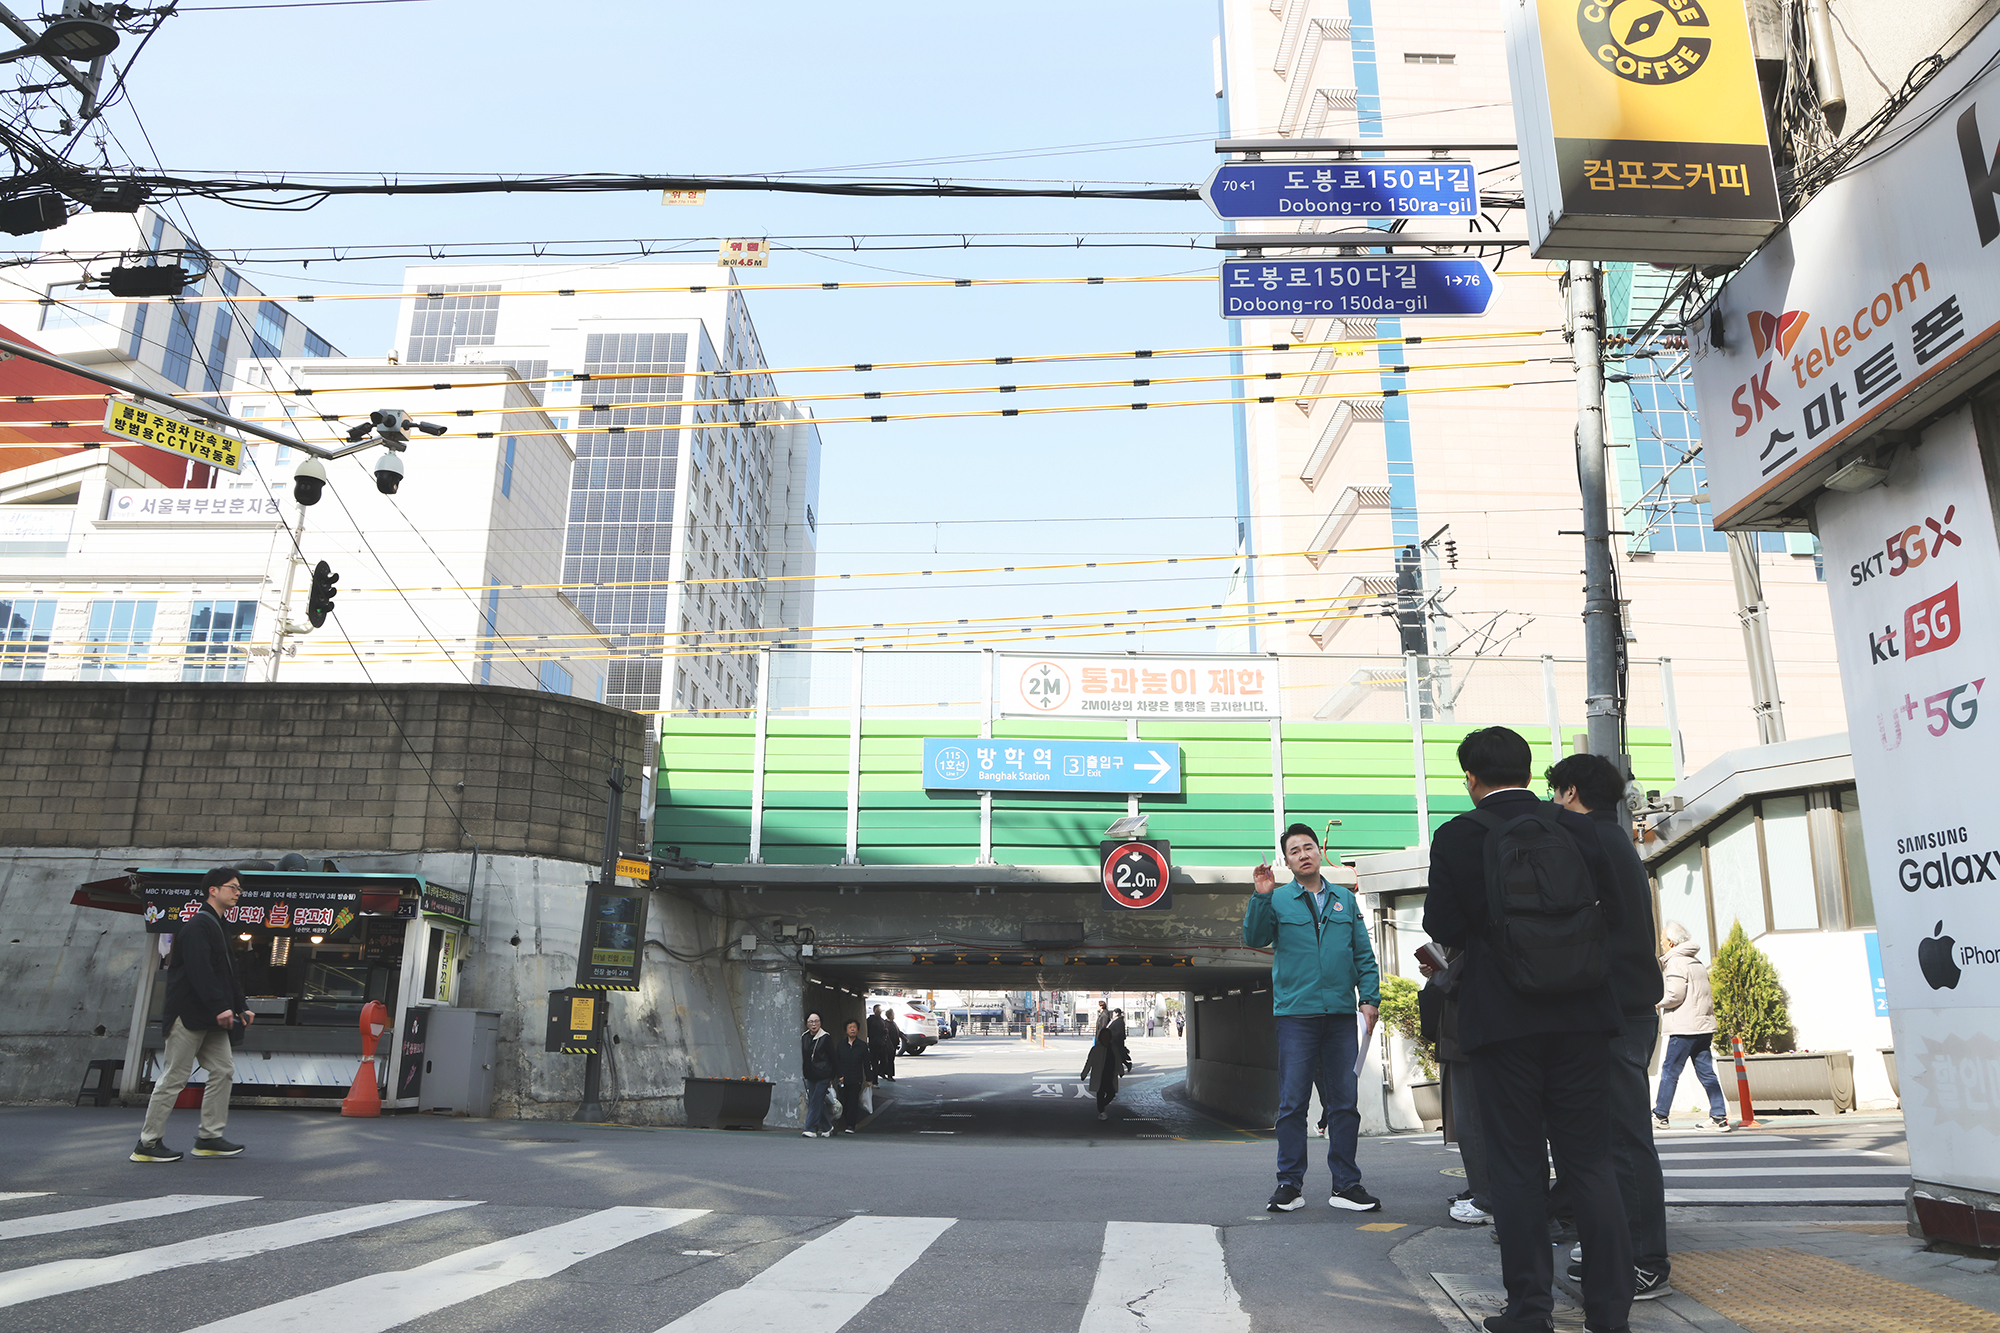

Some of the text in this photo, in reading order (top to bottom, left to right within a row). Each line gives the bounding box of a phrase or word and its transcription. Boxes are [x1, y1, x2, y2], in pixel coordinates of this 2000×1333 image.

[1598, 44, 1701, 80] COFFEE
[1222, 180, 1238, 191] 70
[1284, 168, 1470, 192] 도봉로150라길
[1584, 159, 1750, 196] 컴포즈커피
[1279, 197, 1472, 215] Dobong-ro 150ra-gil
[1230, 265, 1417, 290] 도봉로150다길
[1463, 274, 1481, 287] 76
[1230, 296, 1428, 314] Dobong-ro 150da-gil
[1731, 261, 1931, 438] SK telecom
[1760, 293, 1965, 476] 스마트폰
[123, 406, 233, 452] 불법 주정차 단속 및
[114, 417, 236, 467] 방범용CCTV작동중
[1850, 551, 1884, 587] SKT
[1868, 600, 1951, 665] kt 5G
[1029, 678, 1061, 695] 2M
[1081, 667, 1265, 695] 통과높이 제한
[1081, 700, 1268, 713] 2M이상의 차량은 통행을 금지합니다.
[940, 760, 965, 772] 1호선
[945, 751, 961, 759] 115
[1068, 755, 1124, 774] 3 출입구
[978, 770, 1050, 782] Banghak Station
[1087, 769, 1101, 778] Exit
[1897, 826, 1968, 854] SAMSUNG
[1116, 864, 1157, 888] 2.0m
[269, 905, 288, 926] 불
[293, 908, 334, 926] 닭꼬치
[398, 905, 412, 914] 2-1
[1876, 998, 1889, 1010] 2
[1932, 1054, 2000, 1111] 할인
